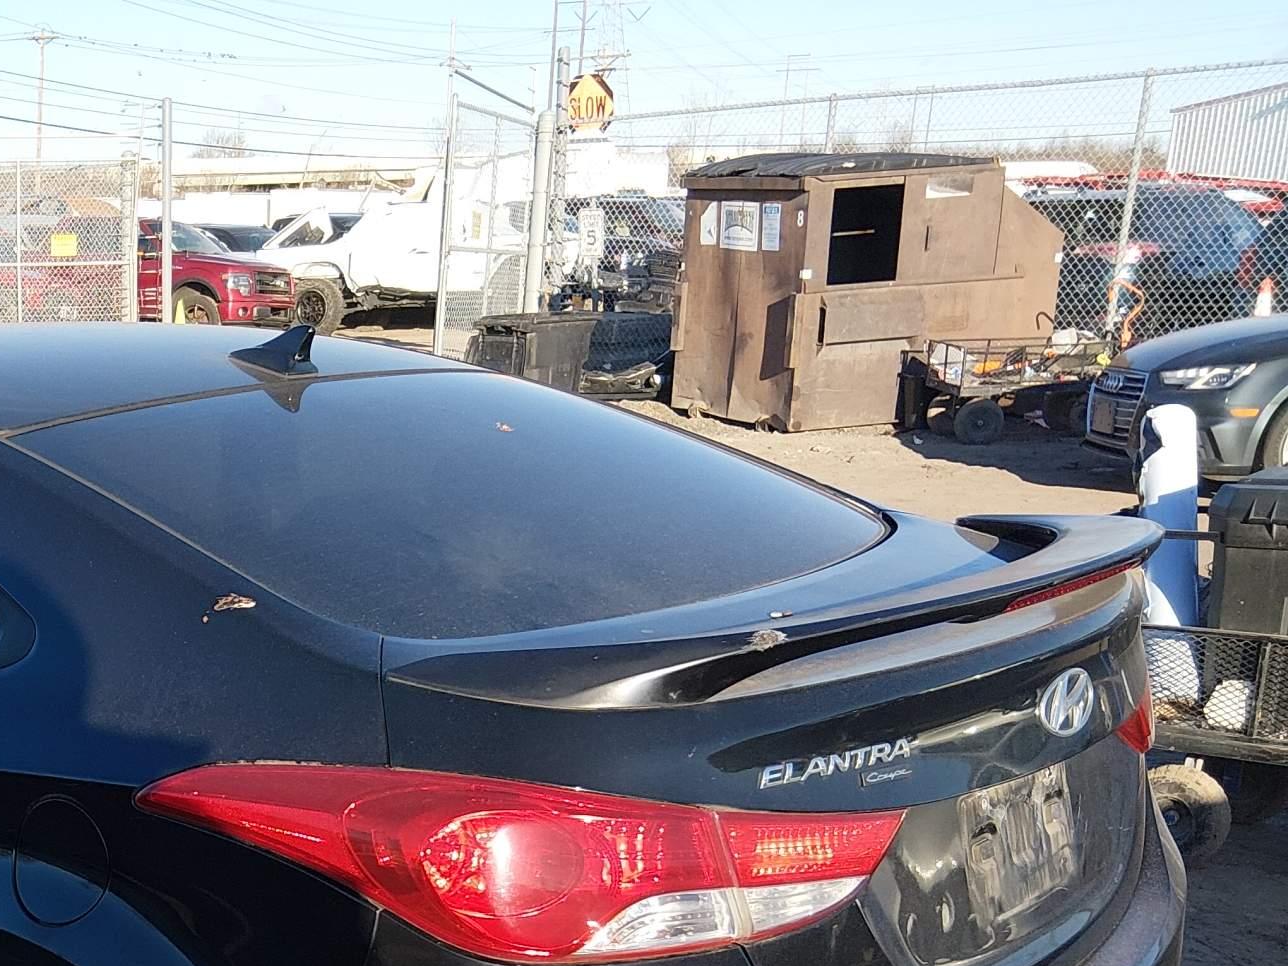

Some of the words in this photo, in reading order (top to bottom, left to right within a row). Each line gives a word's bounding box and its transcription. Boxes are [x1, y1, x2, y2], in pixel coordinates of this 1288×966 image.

[569, 95, 607, 121] SLOW
[797, 209, 805, 227] 8
[587, 230, 597, 246] 5
[759, 738, 911, 789] ELANTRA
